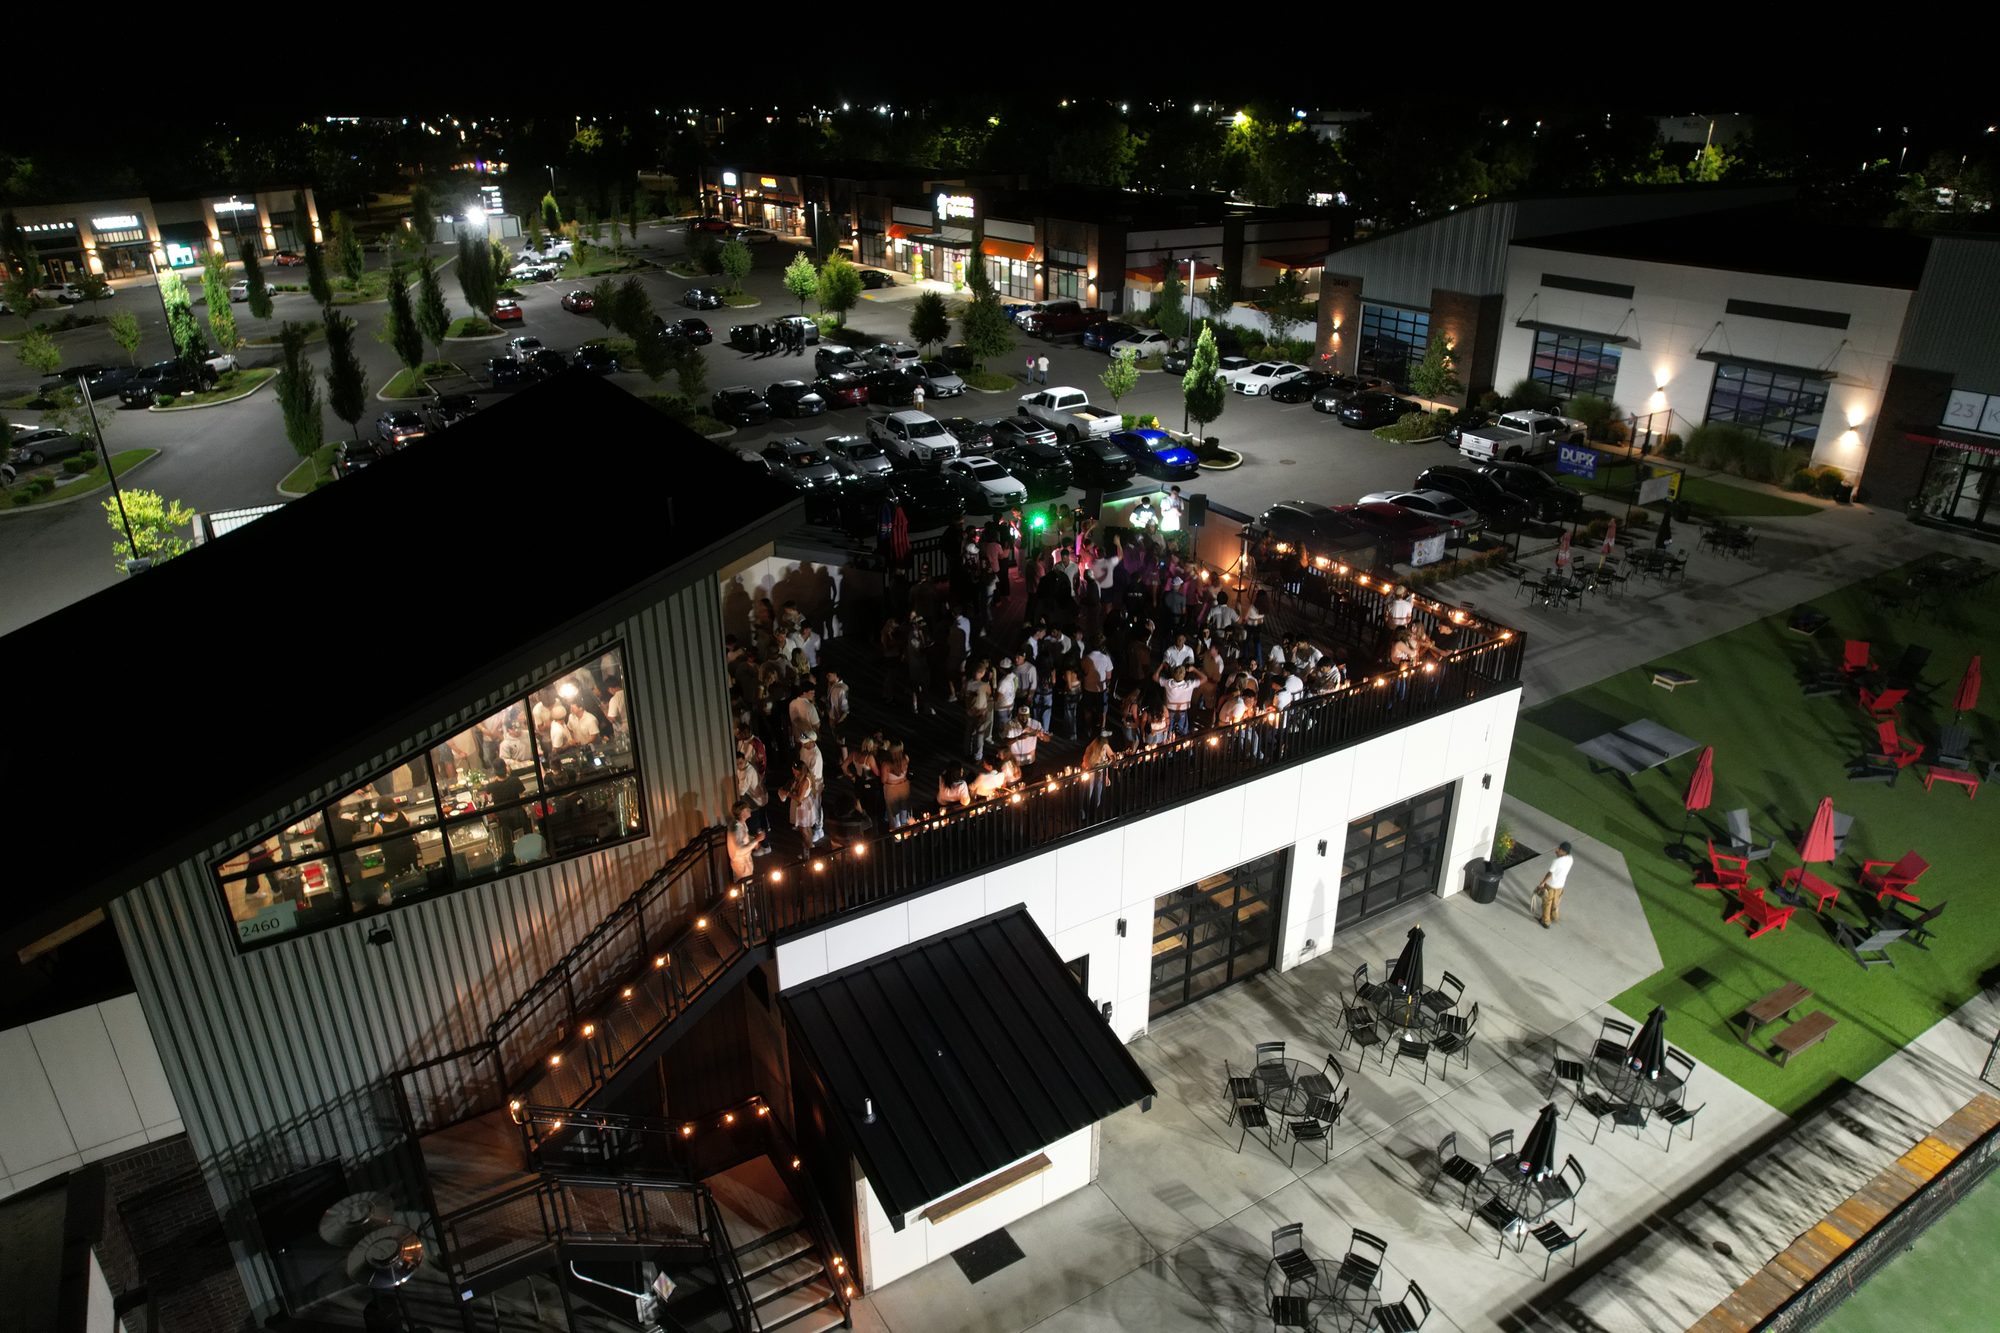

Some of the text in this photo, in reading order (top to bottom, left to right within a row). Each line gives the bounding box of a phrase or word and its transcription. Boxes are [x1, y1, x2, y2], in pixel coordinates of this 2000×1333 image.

[1951, 402, 1975, 418] 23
[1938, 439, 1983, 452] PICKLEBALL
[1561, 447, 1595, 466] DUPR
[241, 917, 280, 937] 2460
